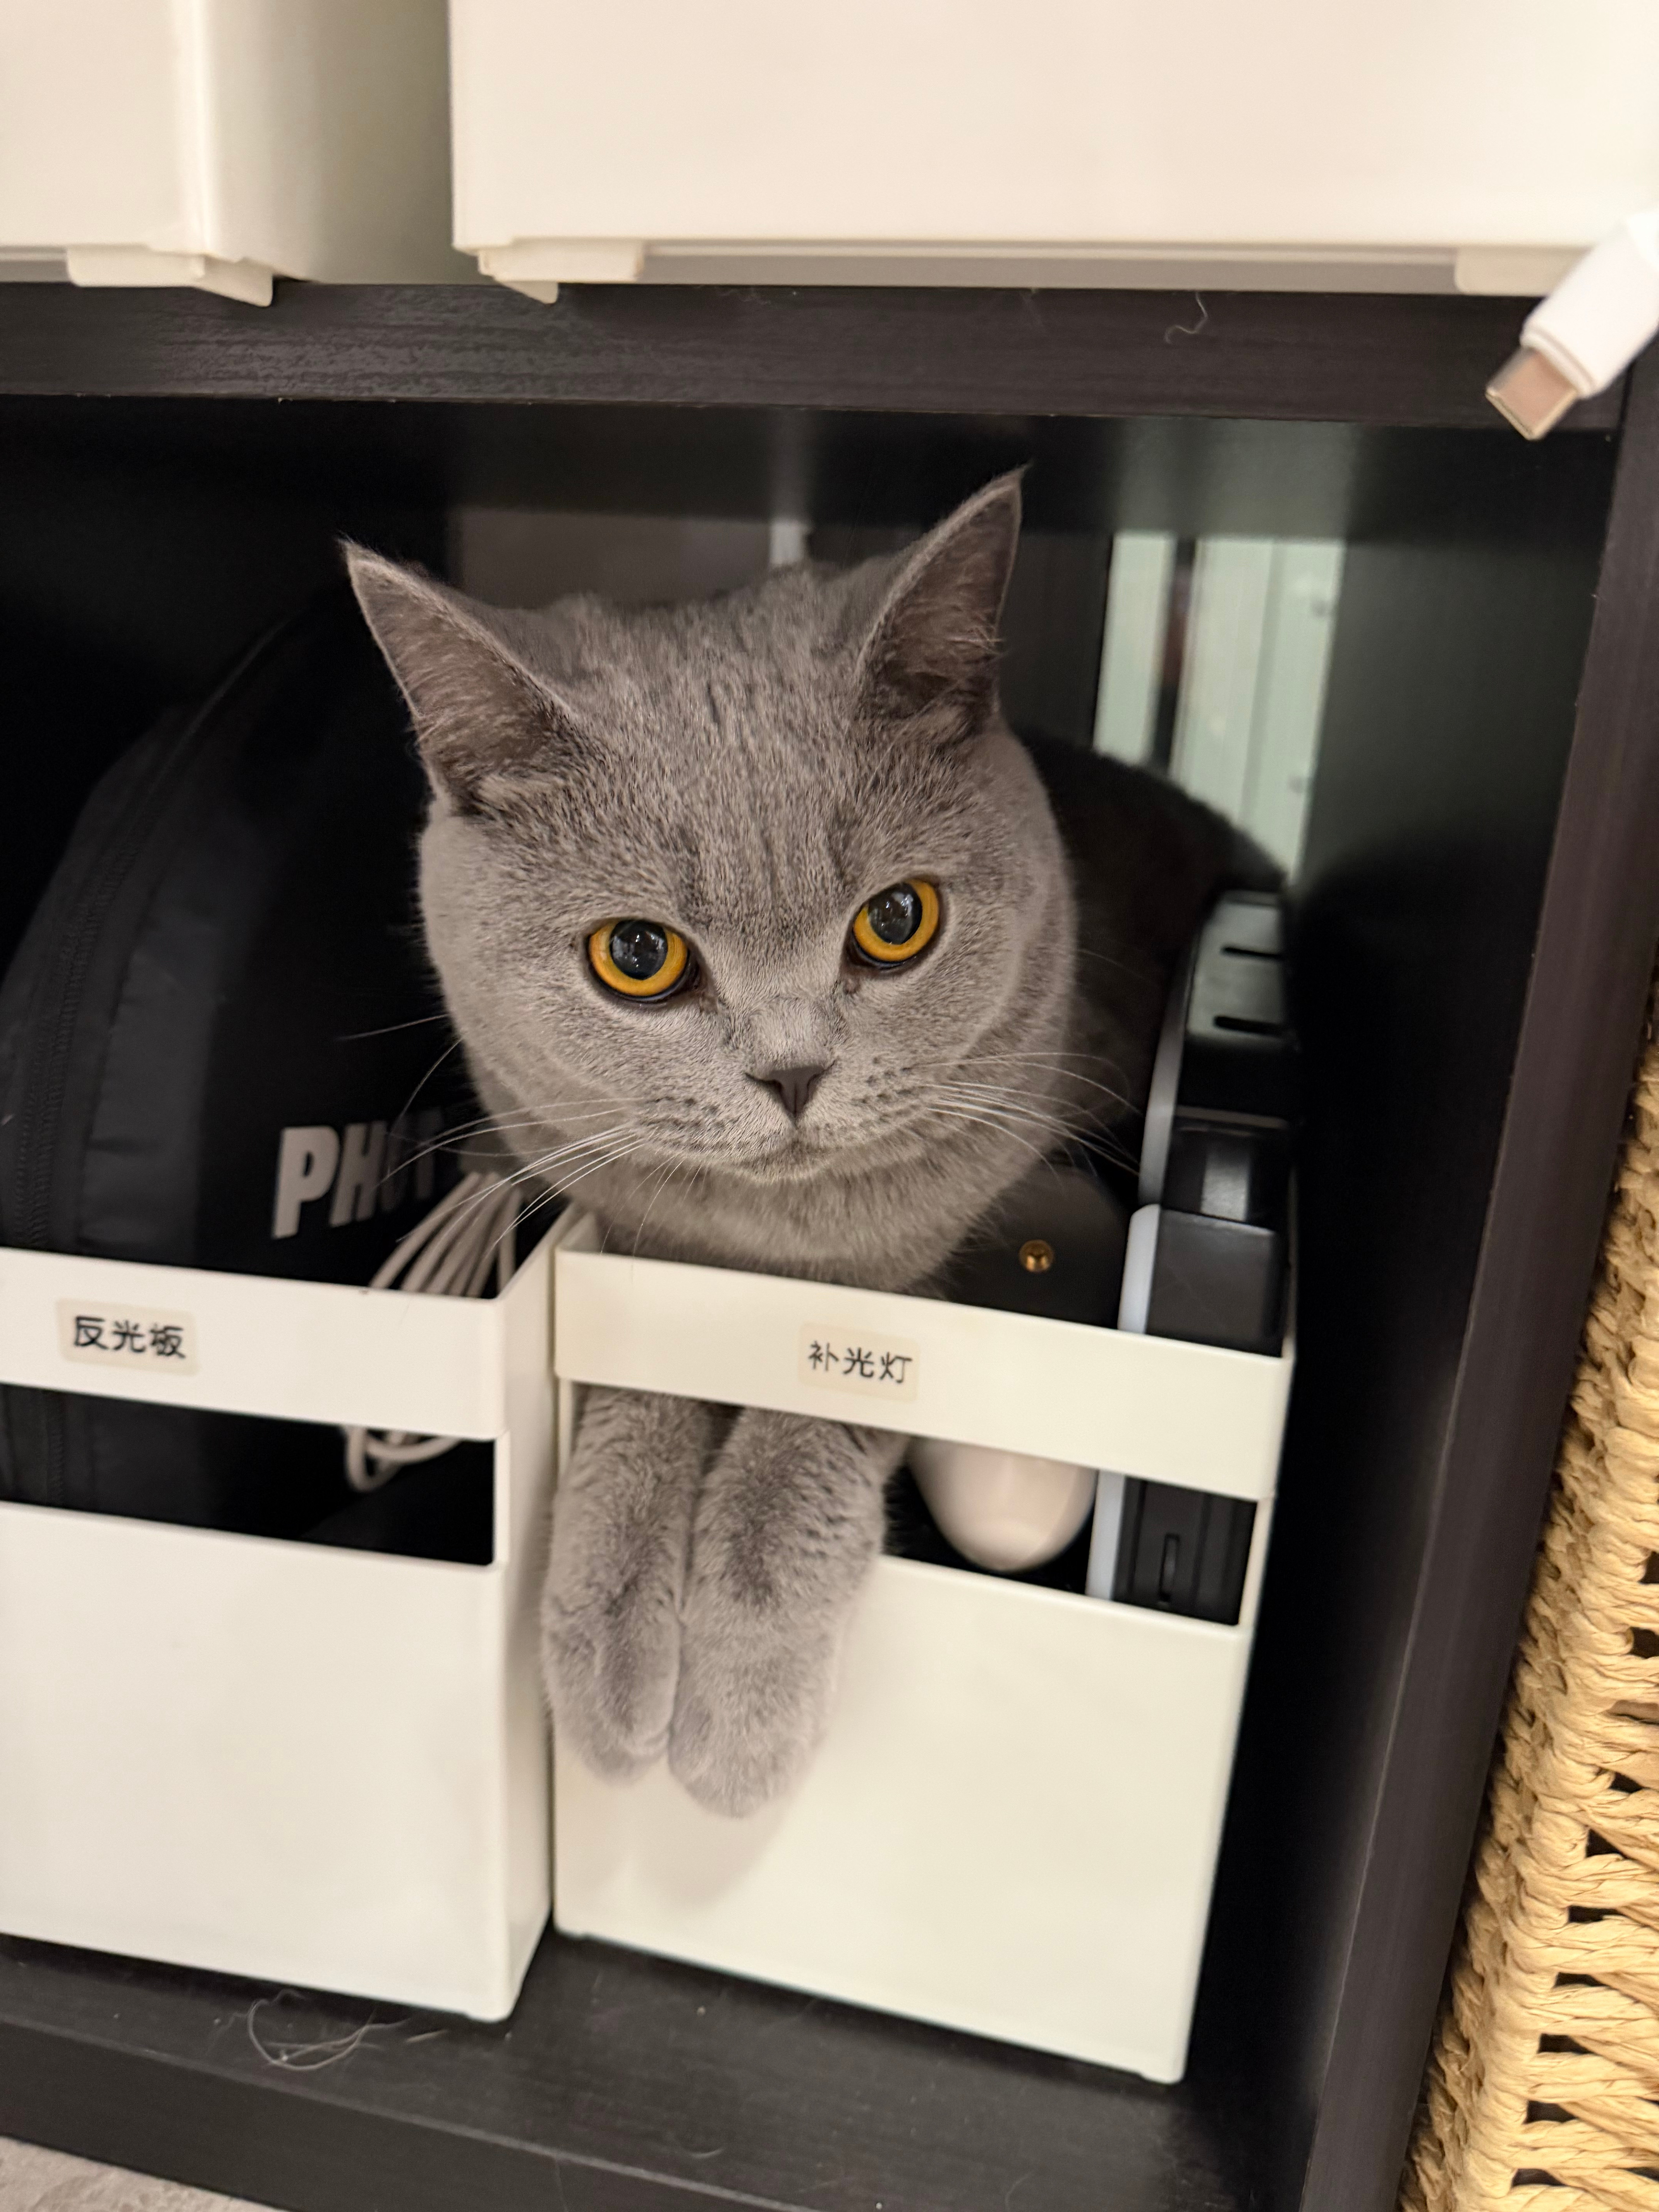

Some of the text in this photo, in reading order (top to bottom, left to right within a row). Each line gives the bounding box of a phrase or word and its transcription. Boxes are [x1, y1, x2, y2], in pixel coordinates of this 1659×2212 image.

[74, 1315, 186, 1358] 反光板
[808, 1340, 913, 1384] 补光灯
